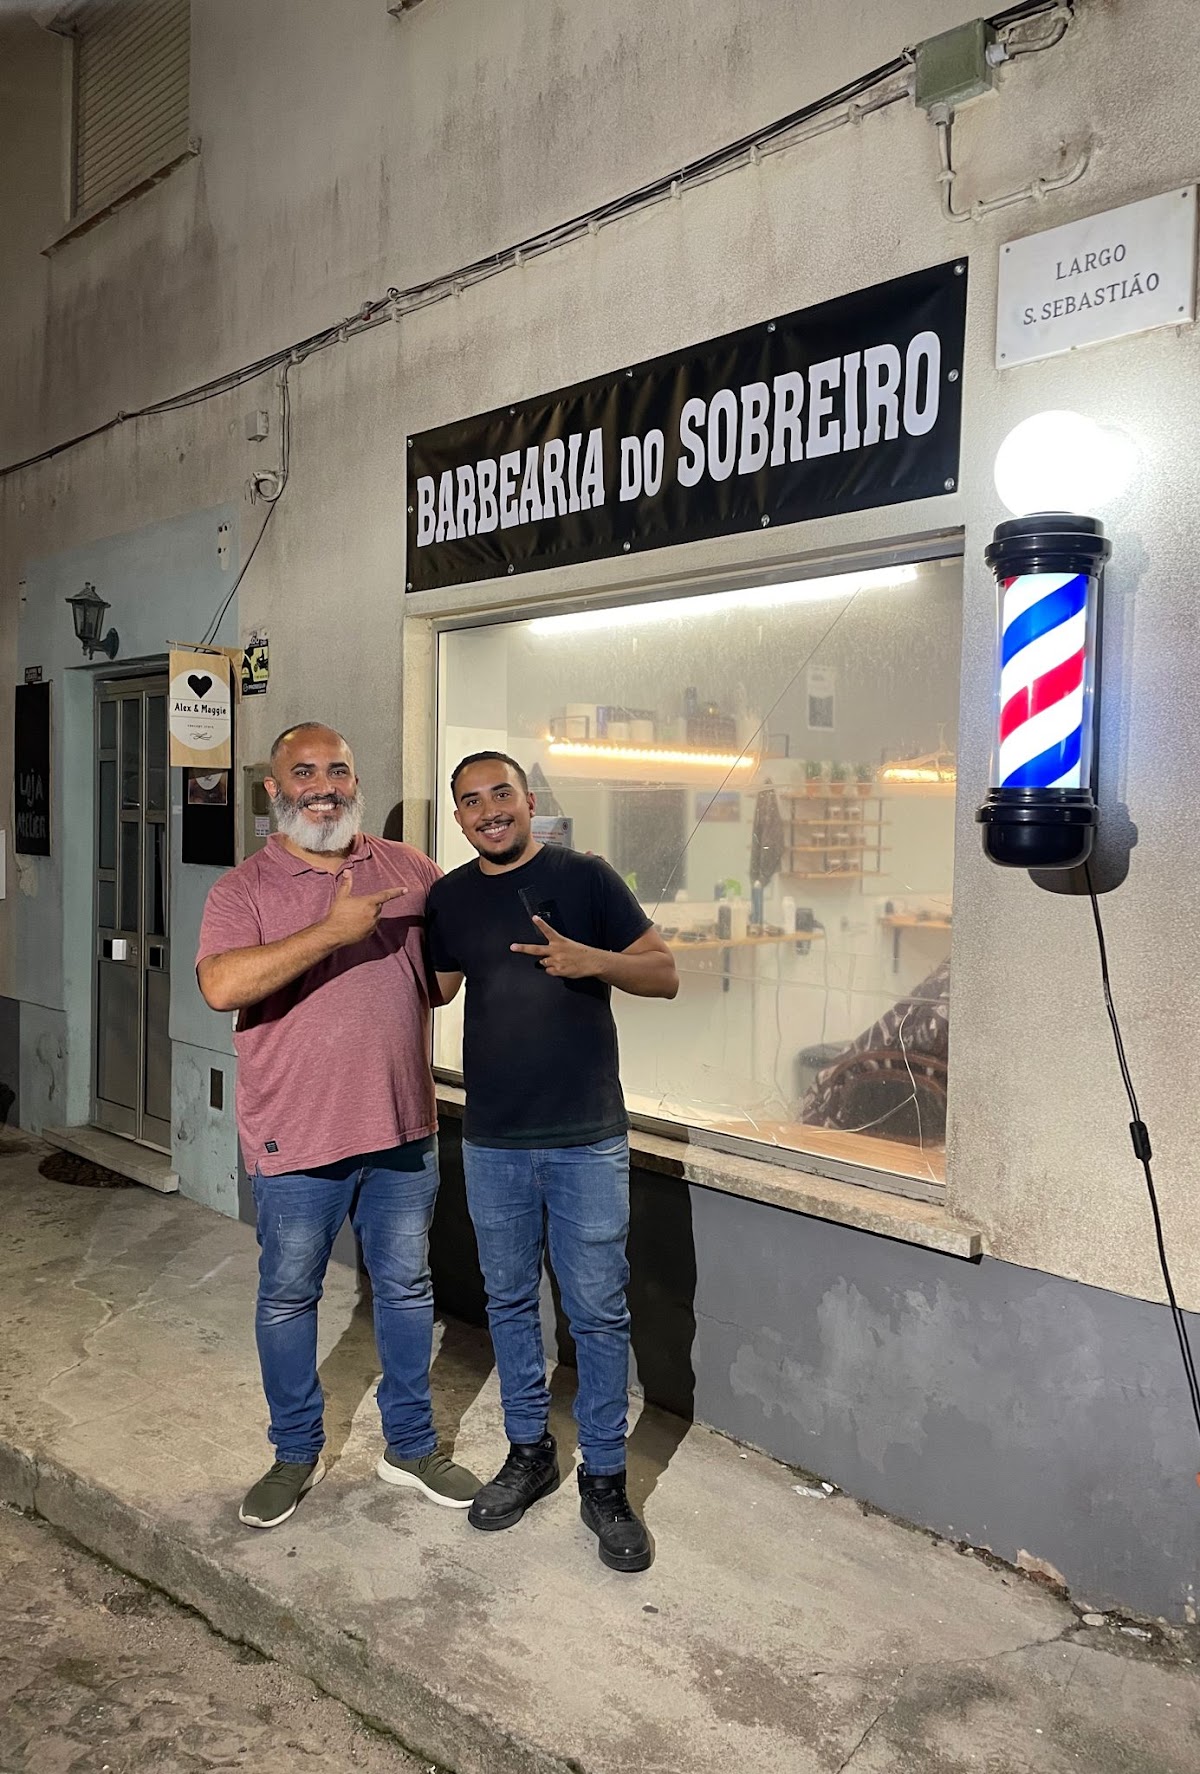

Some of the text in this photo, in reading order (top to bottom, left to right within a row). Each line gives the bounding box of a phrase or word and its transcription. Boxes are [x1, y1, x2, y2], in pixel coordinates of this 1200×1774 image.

[1056, 244, 1127, 280] LARGO
[1041, 272, 1160, 320] SEBASTIÃO
[416, 331, 941, 548] BARBEARIA DO SOBREIRO
[174, 702, 227, 716] Alex & Maggie
